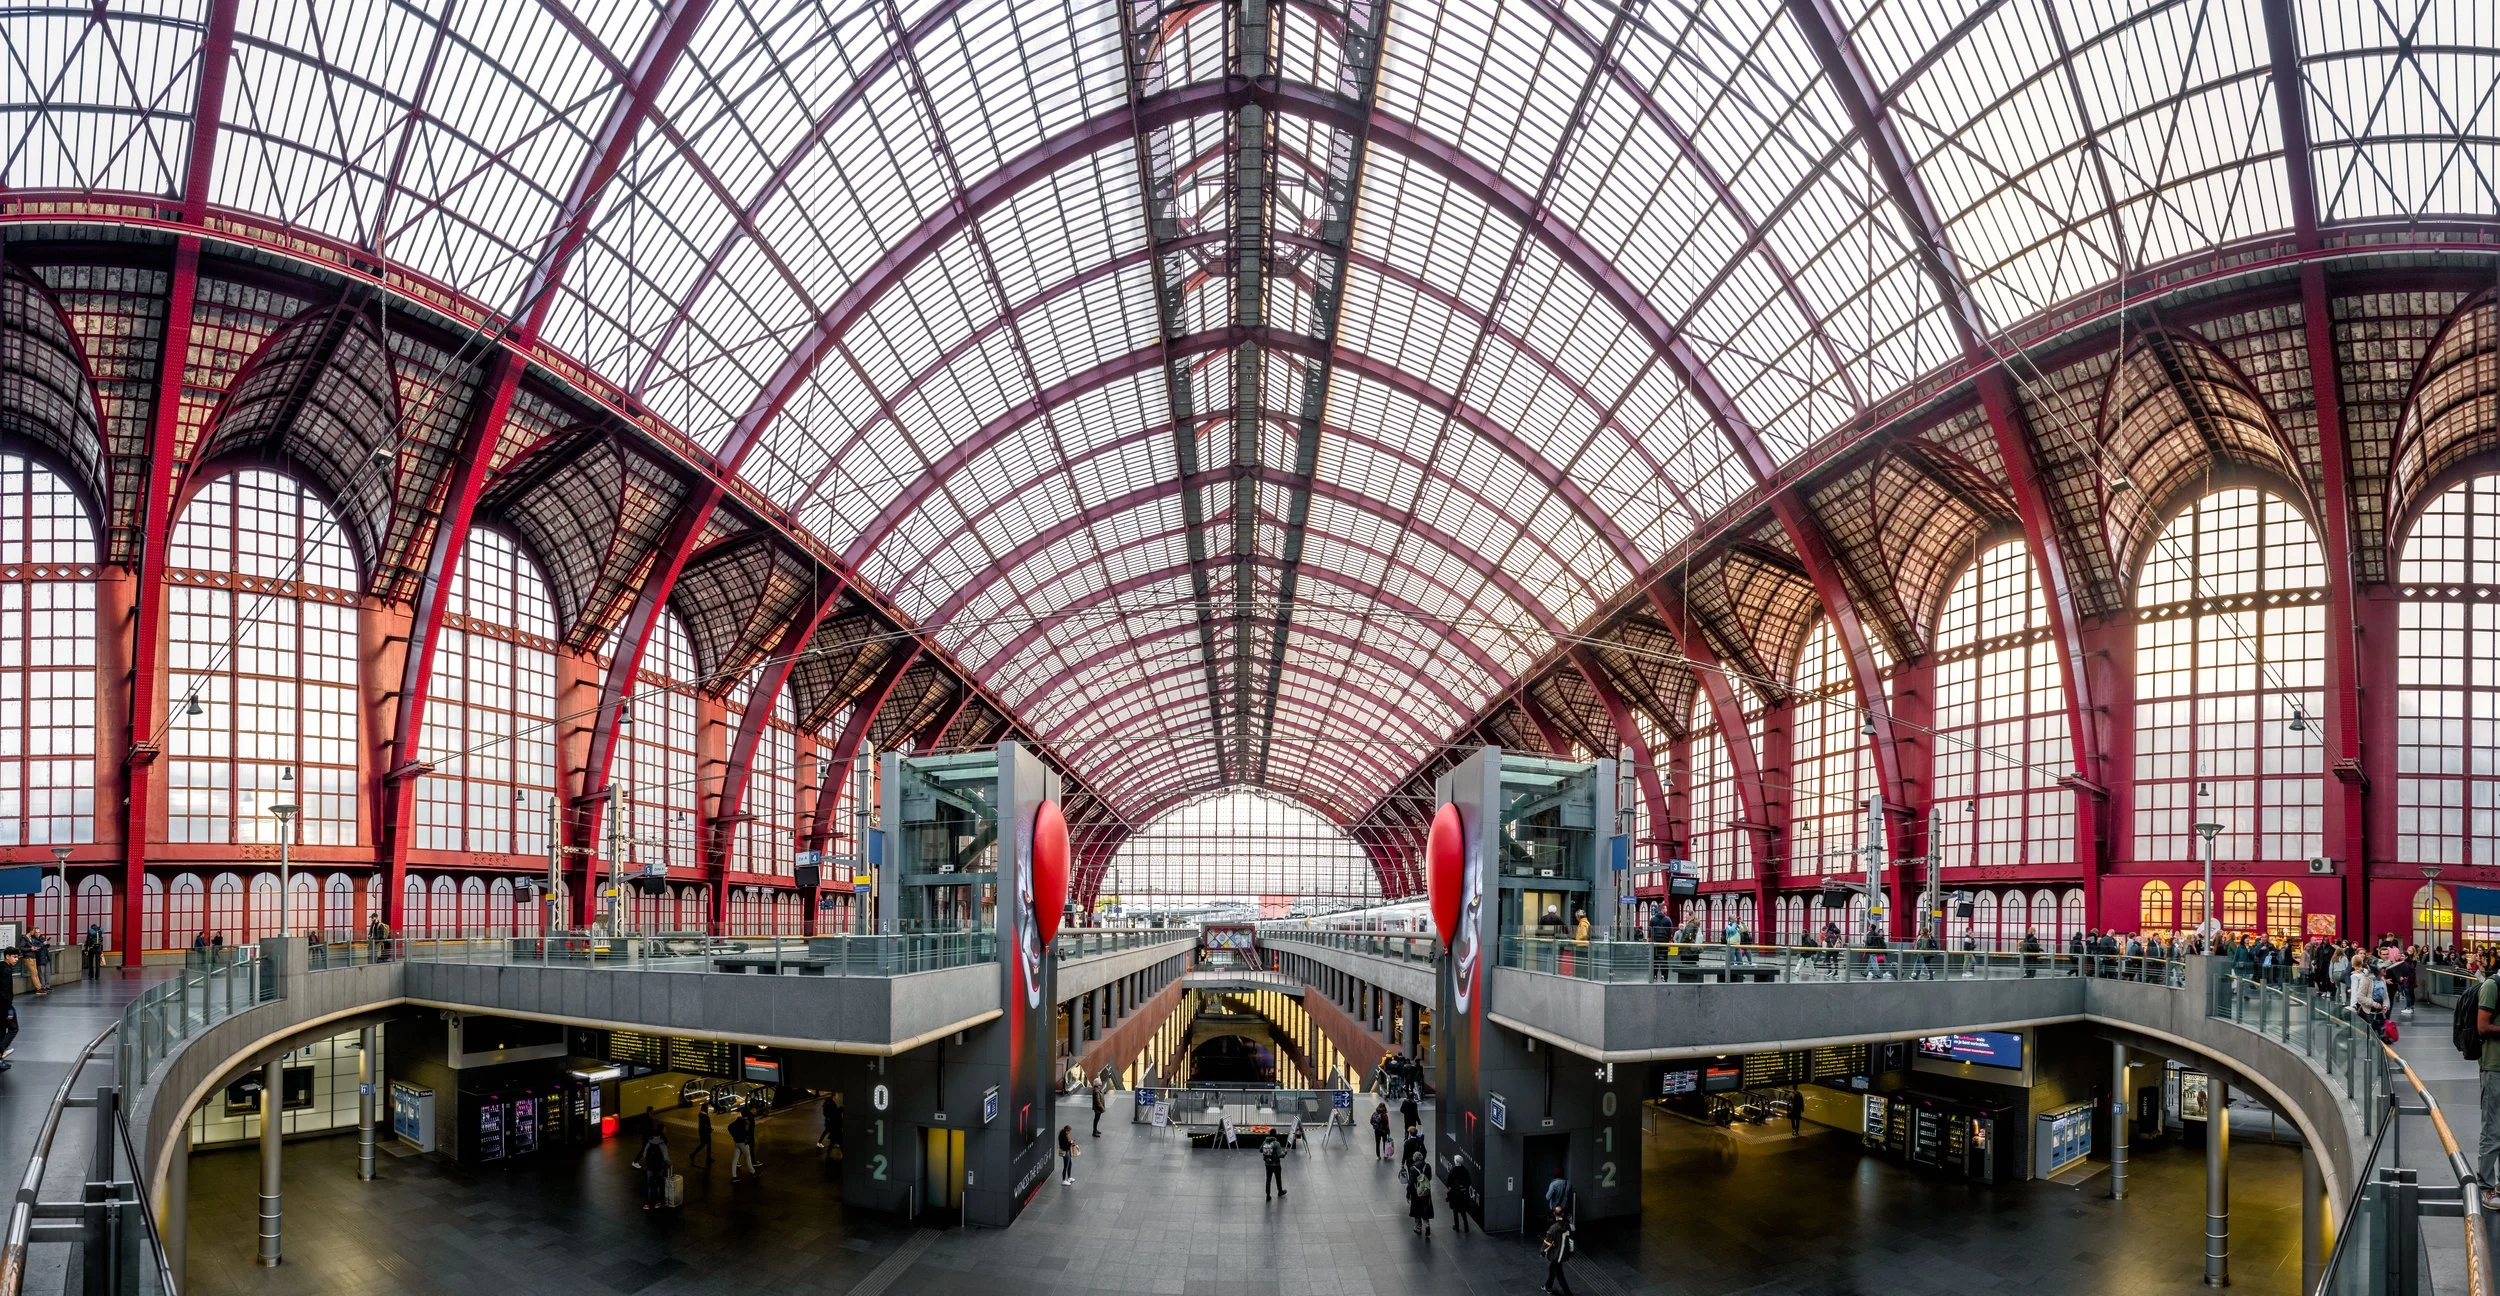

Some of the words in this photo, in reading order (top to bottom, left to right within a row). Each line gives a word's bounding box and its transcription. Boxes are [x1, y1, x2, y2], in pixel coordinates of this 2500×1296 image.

[874, 1085, 889, 1111] 0
[1602, 1092, 1617, 1117] 0
[866, 1154, 888, 1181] -2
[1594, 1161, 1617, 1188] -2
